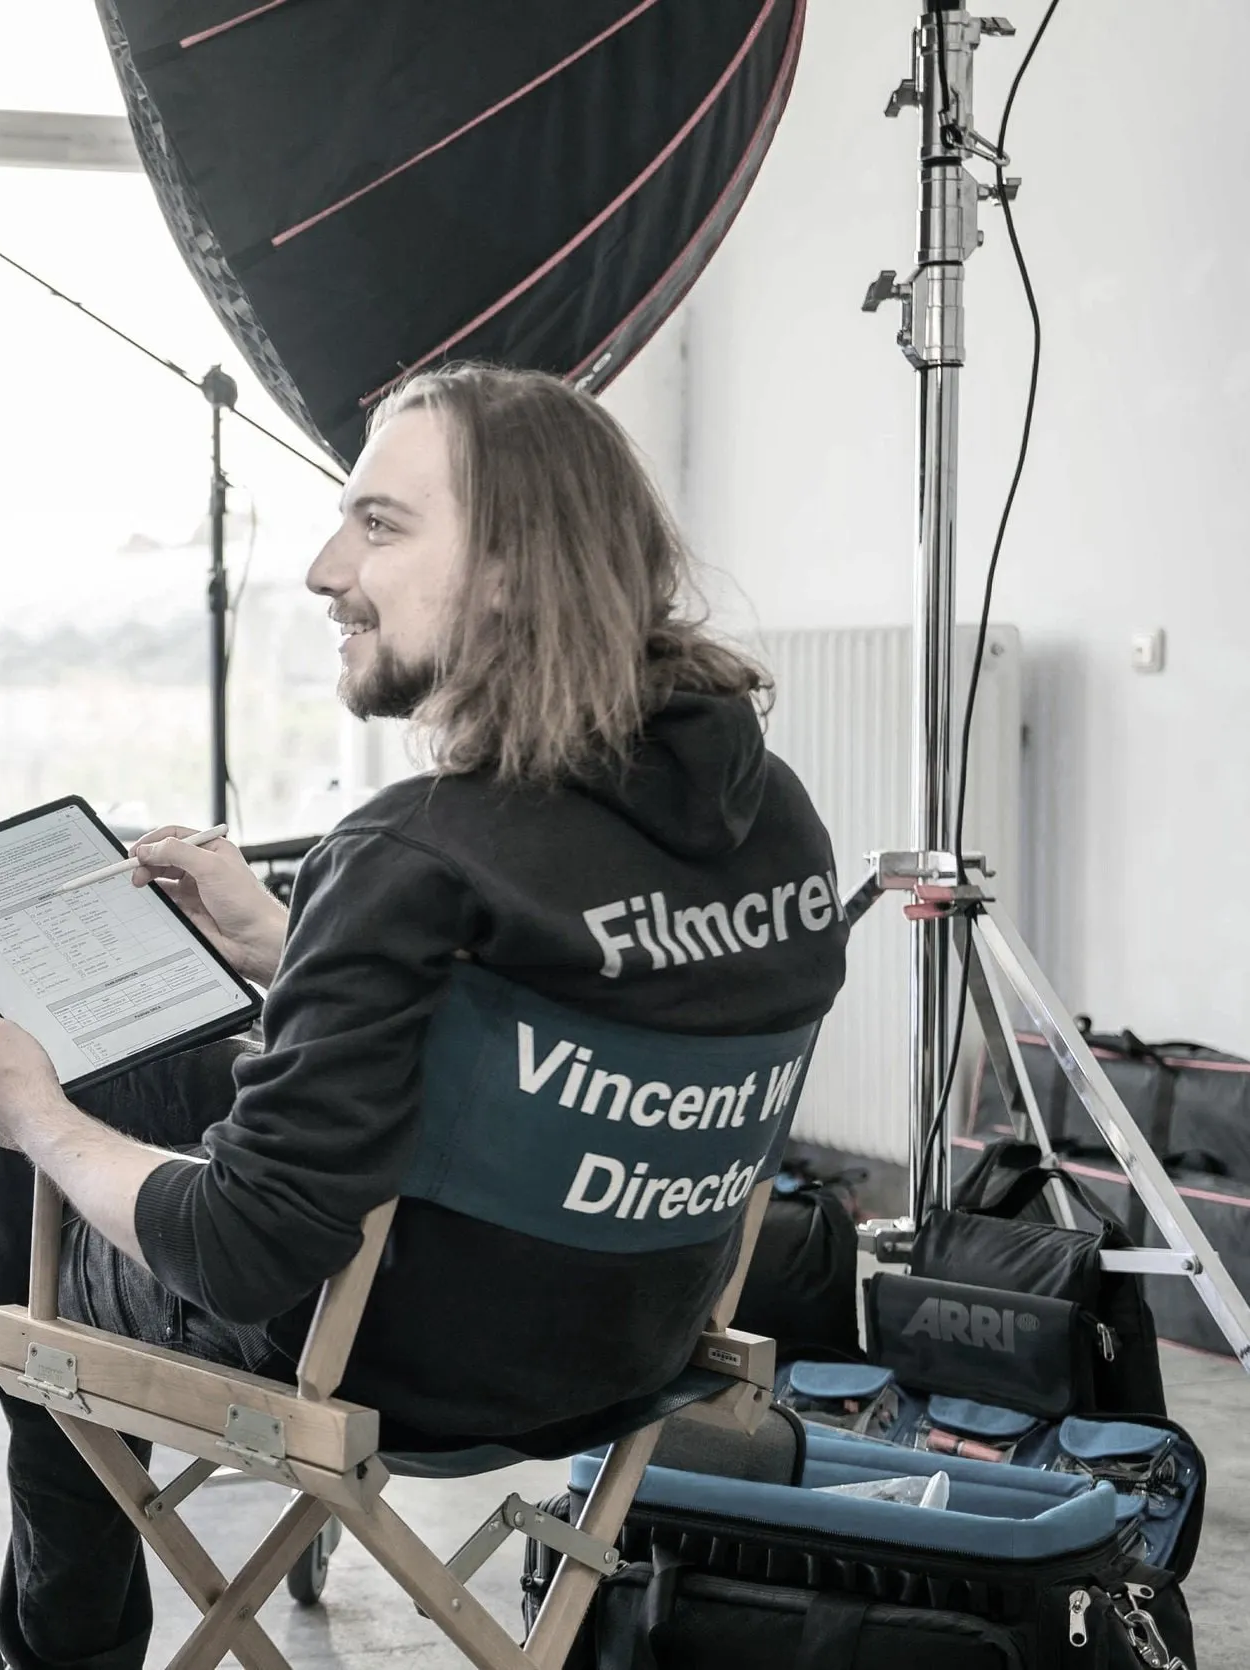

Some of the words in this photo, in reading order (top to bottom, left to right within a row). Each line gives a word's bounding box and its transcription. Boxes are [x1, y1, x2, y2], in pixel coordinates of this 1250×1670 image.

[582, 869, 844, 979] Filmcre
[517, 1021, 757, 1130] Vincent
[759, 1055, 803, 1122] W
[901, 1297, 1015, 1354] ARRI
